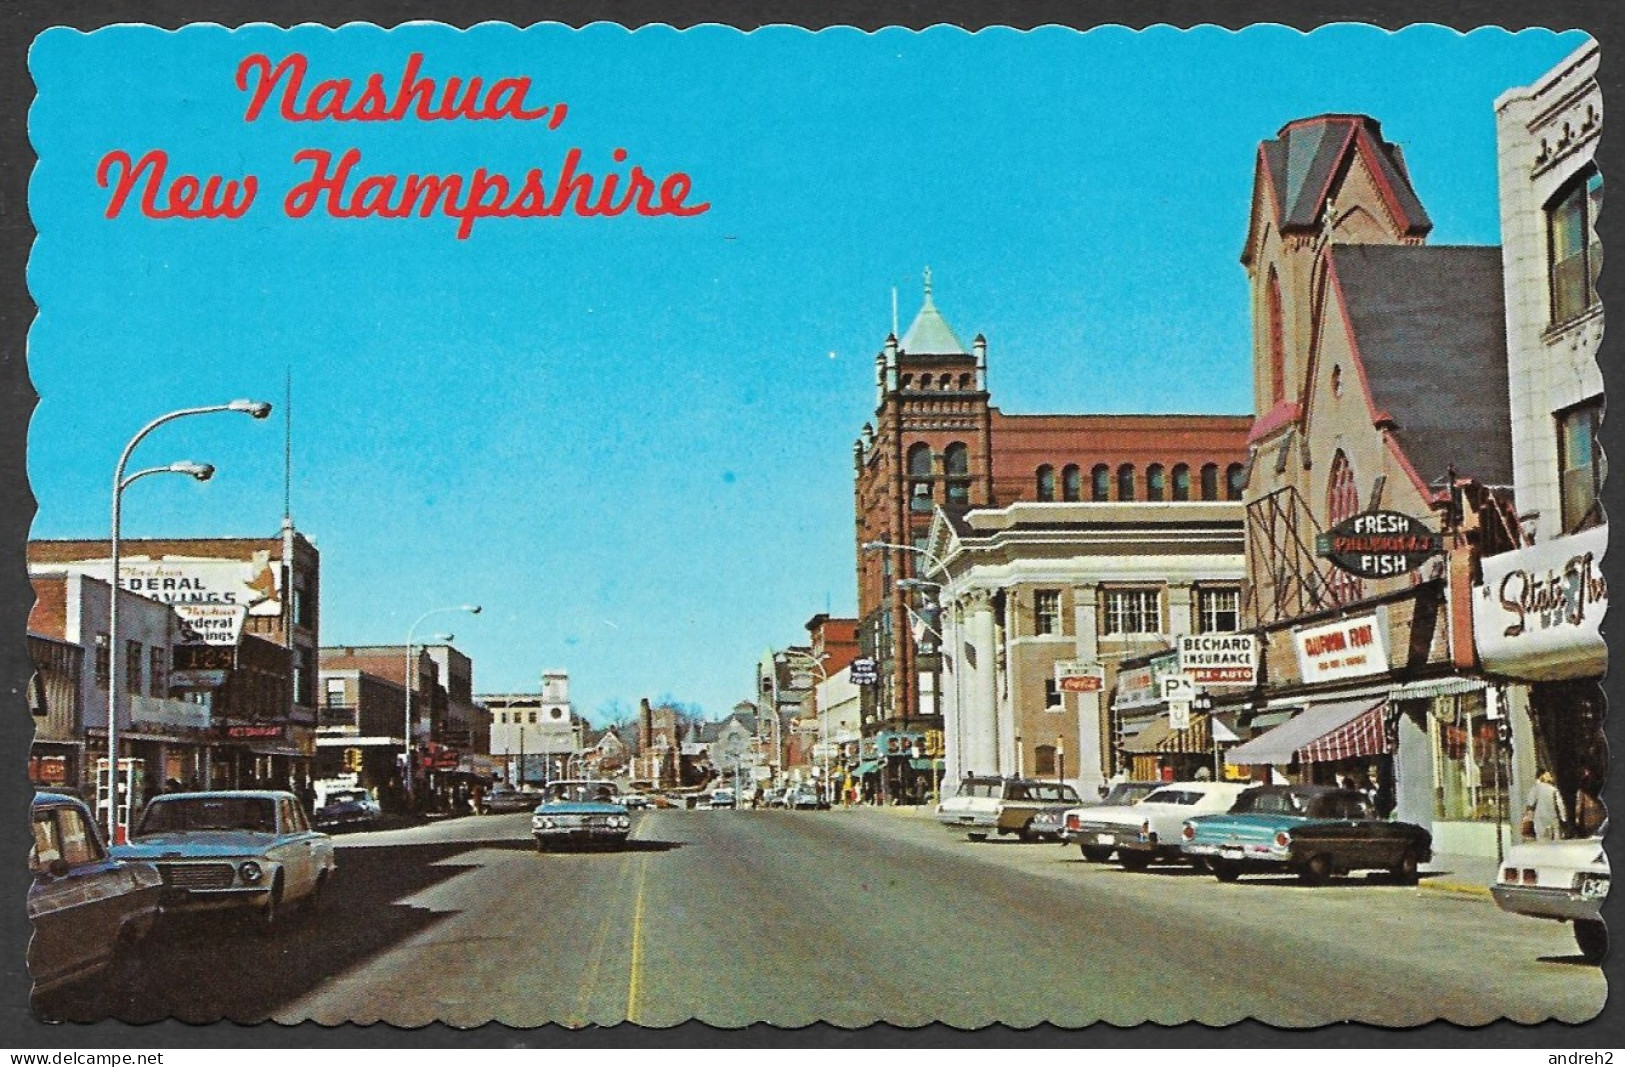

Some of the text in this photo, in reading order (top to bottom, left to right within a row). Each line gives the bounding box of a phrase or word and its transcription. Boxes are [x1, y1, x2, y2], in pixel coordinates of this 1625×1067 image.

[1354, 514, 1409, 534] FRESH
[1361, 555, 1406, 574] FISH
[117, 578, 206, 590] EDERAL
[151, 592, 236, 604] AVINGS
[1183, 638, 1251, 651] BECHARD
[1183, 653, 1250, 664] INSURANCE
[1166, 679, 1179, 697] P
